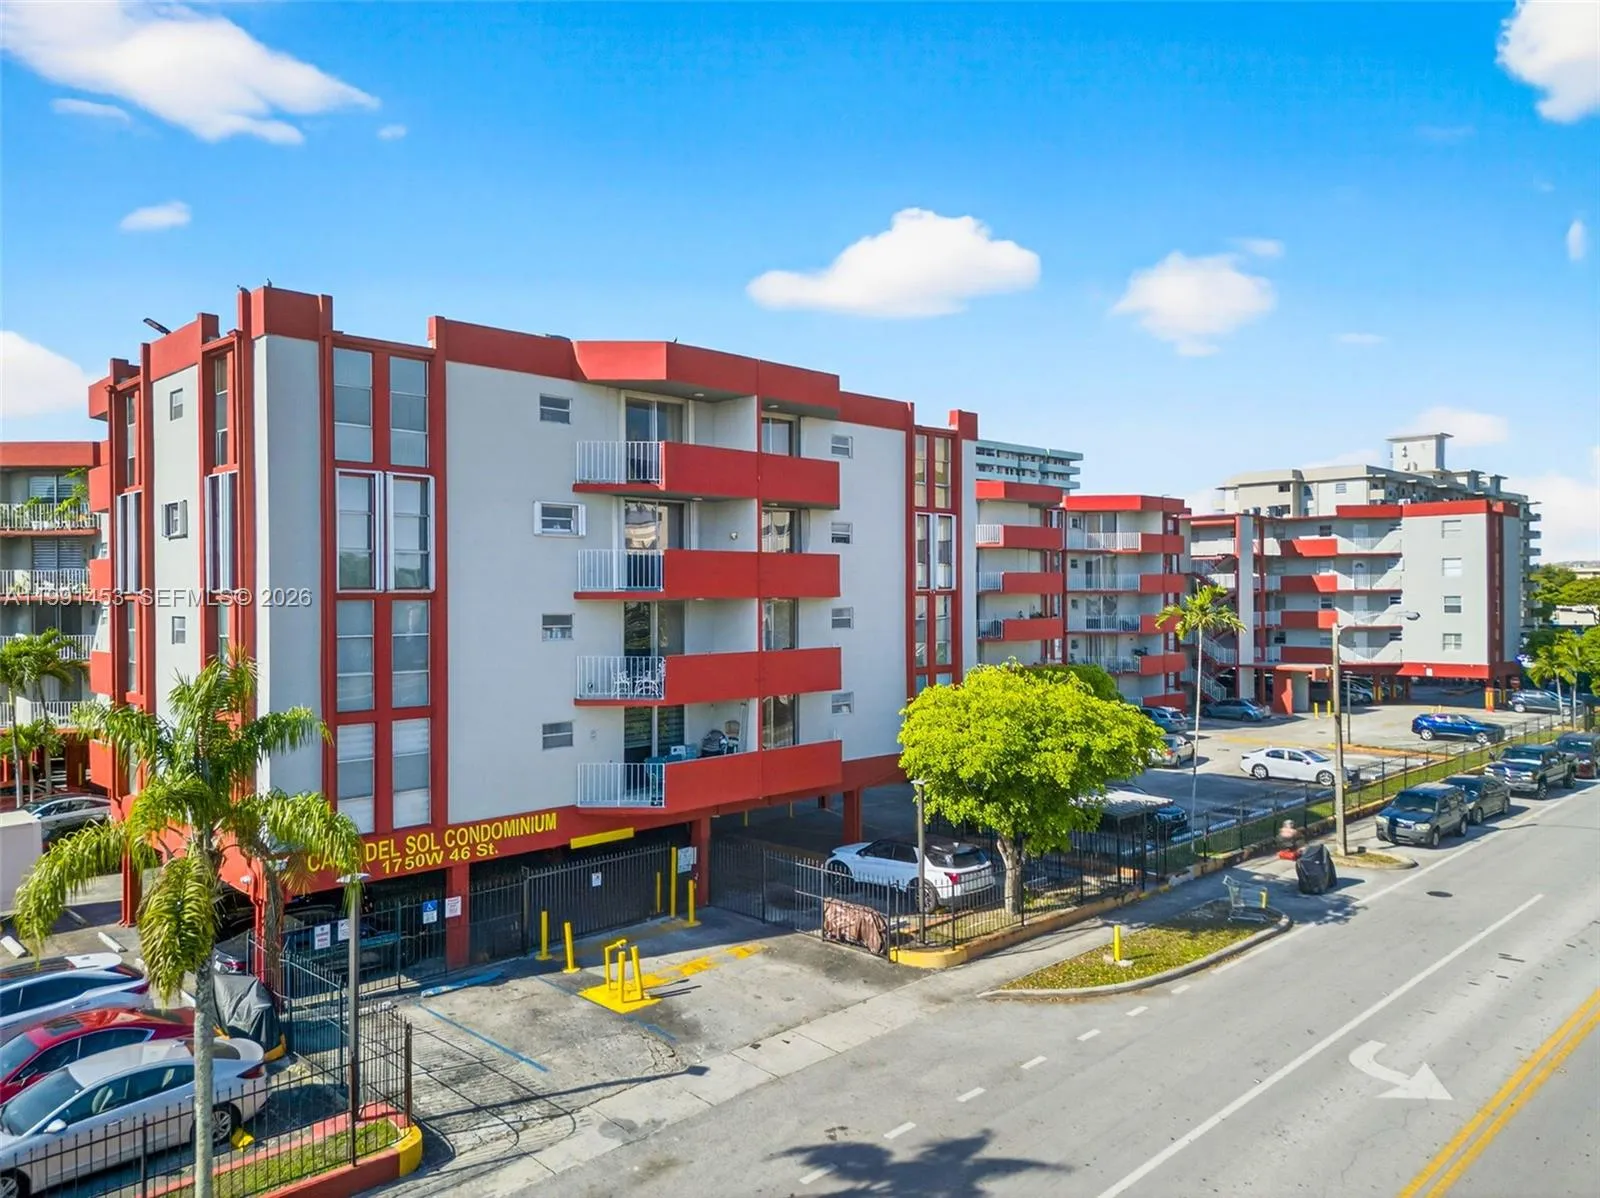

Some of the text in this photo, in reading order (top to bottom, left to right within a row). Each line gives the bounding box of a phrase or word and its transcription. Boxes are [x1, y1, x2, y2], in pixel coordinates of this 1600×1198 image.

[365, 839, 401, 863] DEL
[405, 832, 441, 855] SOL
[444, 811, 557, 848] CONDOMINIUM
[449, 846, 471, 861] 46
[476, 842, 499, 857] St.
